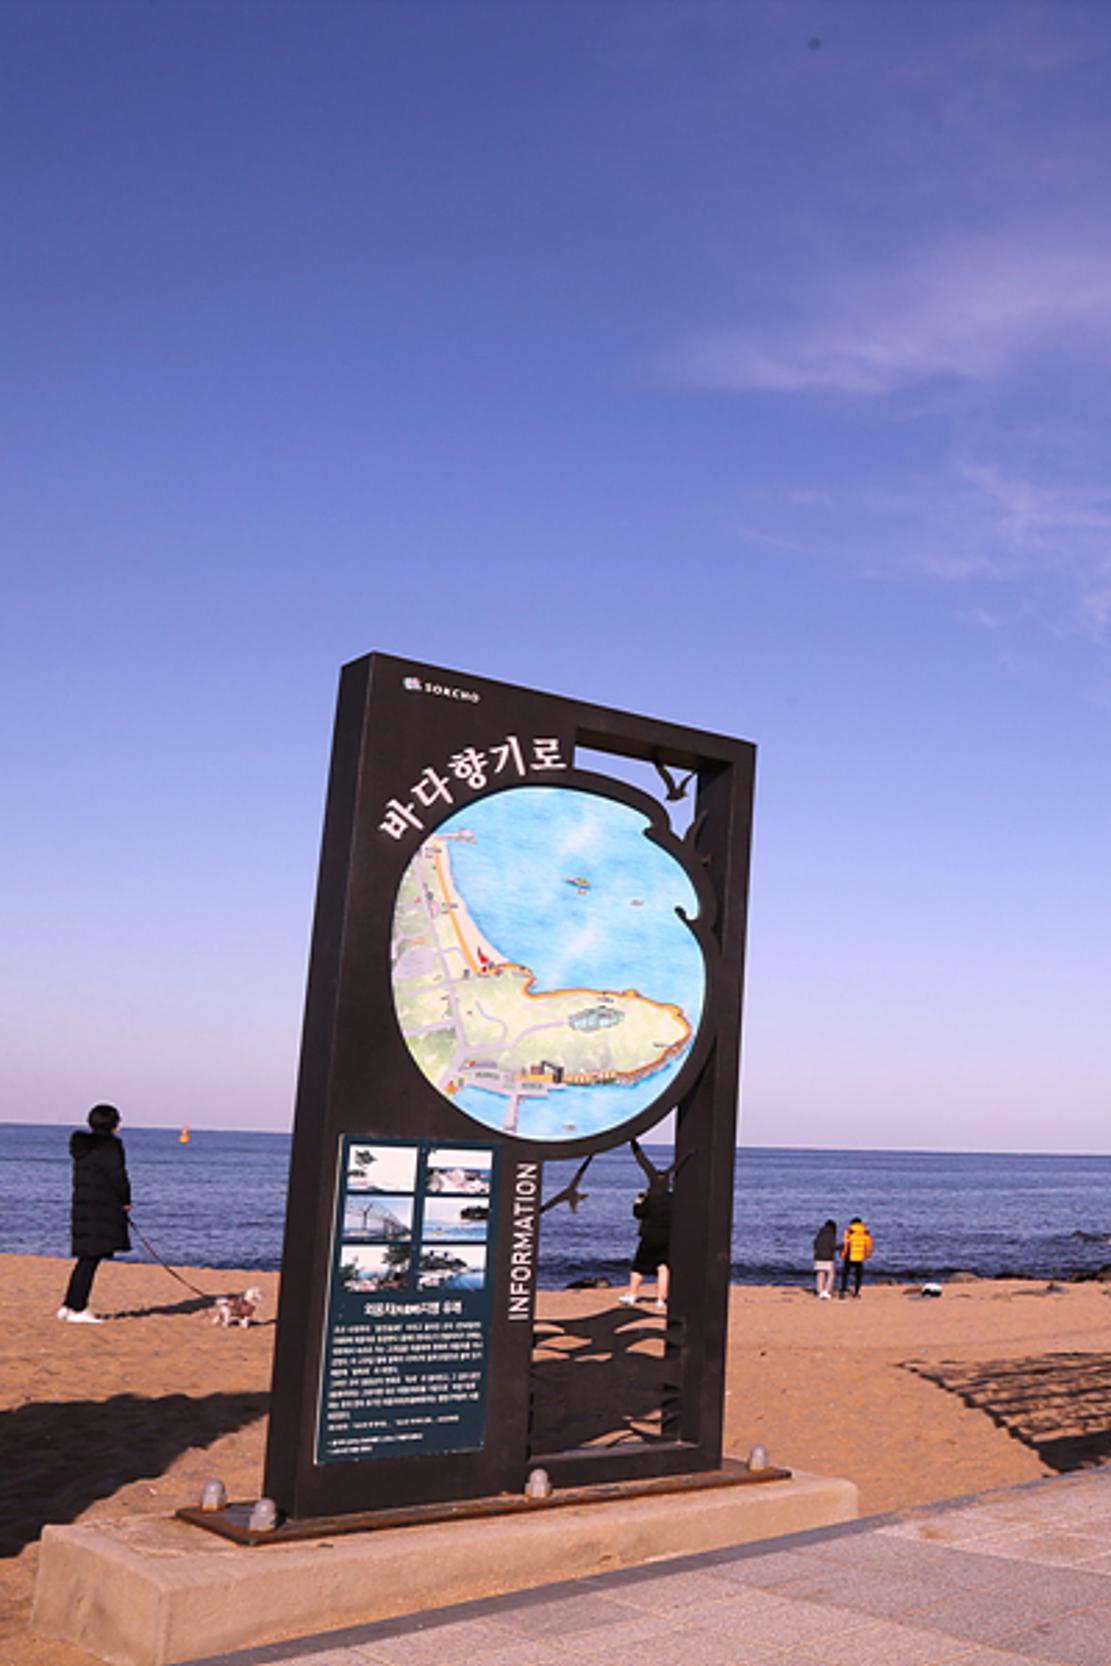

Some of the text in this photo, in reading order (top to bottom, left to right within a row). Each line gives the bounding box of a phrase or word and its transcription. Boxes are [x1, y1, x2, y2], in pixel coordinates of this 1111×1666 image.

[424, 682, 481, 703] SOKCHO
[377, 735, 567, 841] 바다향기로
[507, 1162, 539, 1321] INFORMATION
